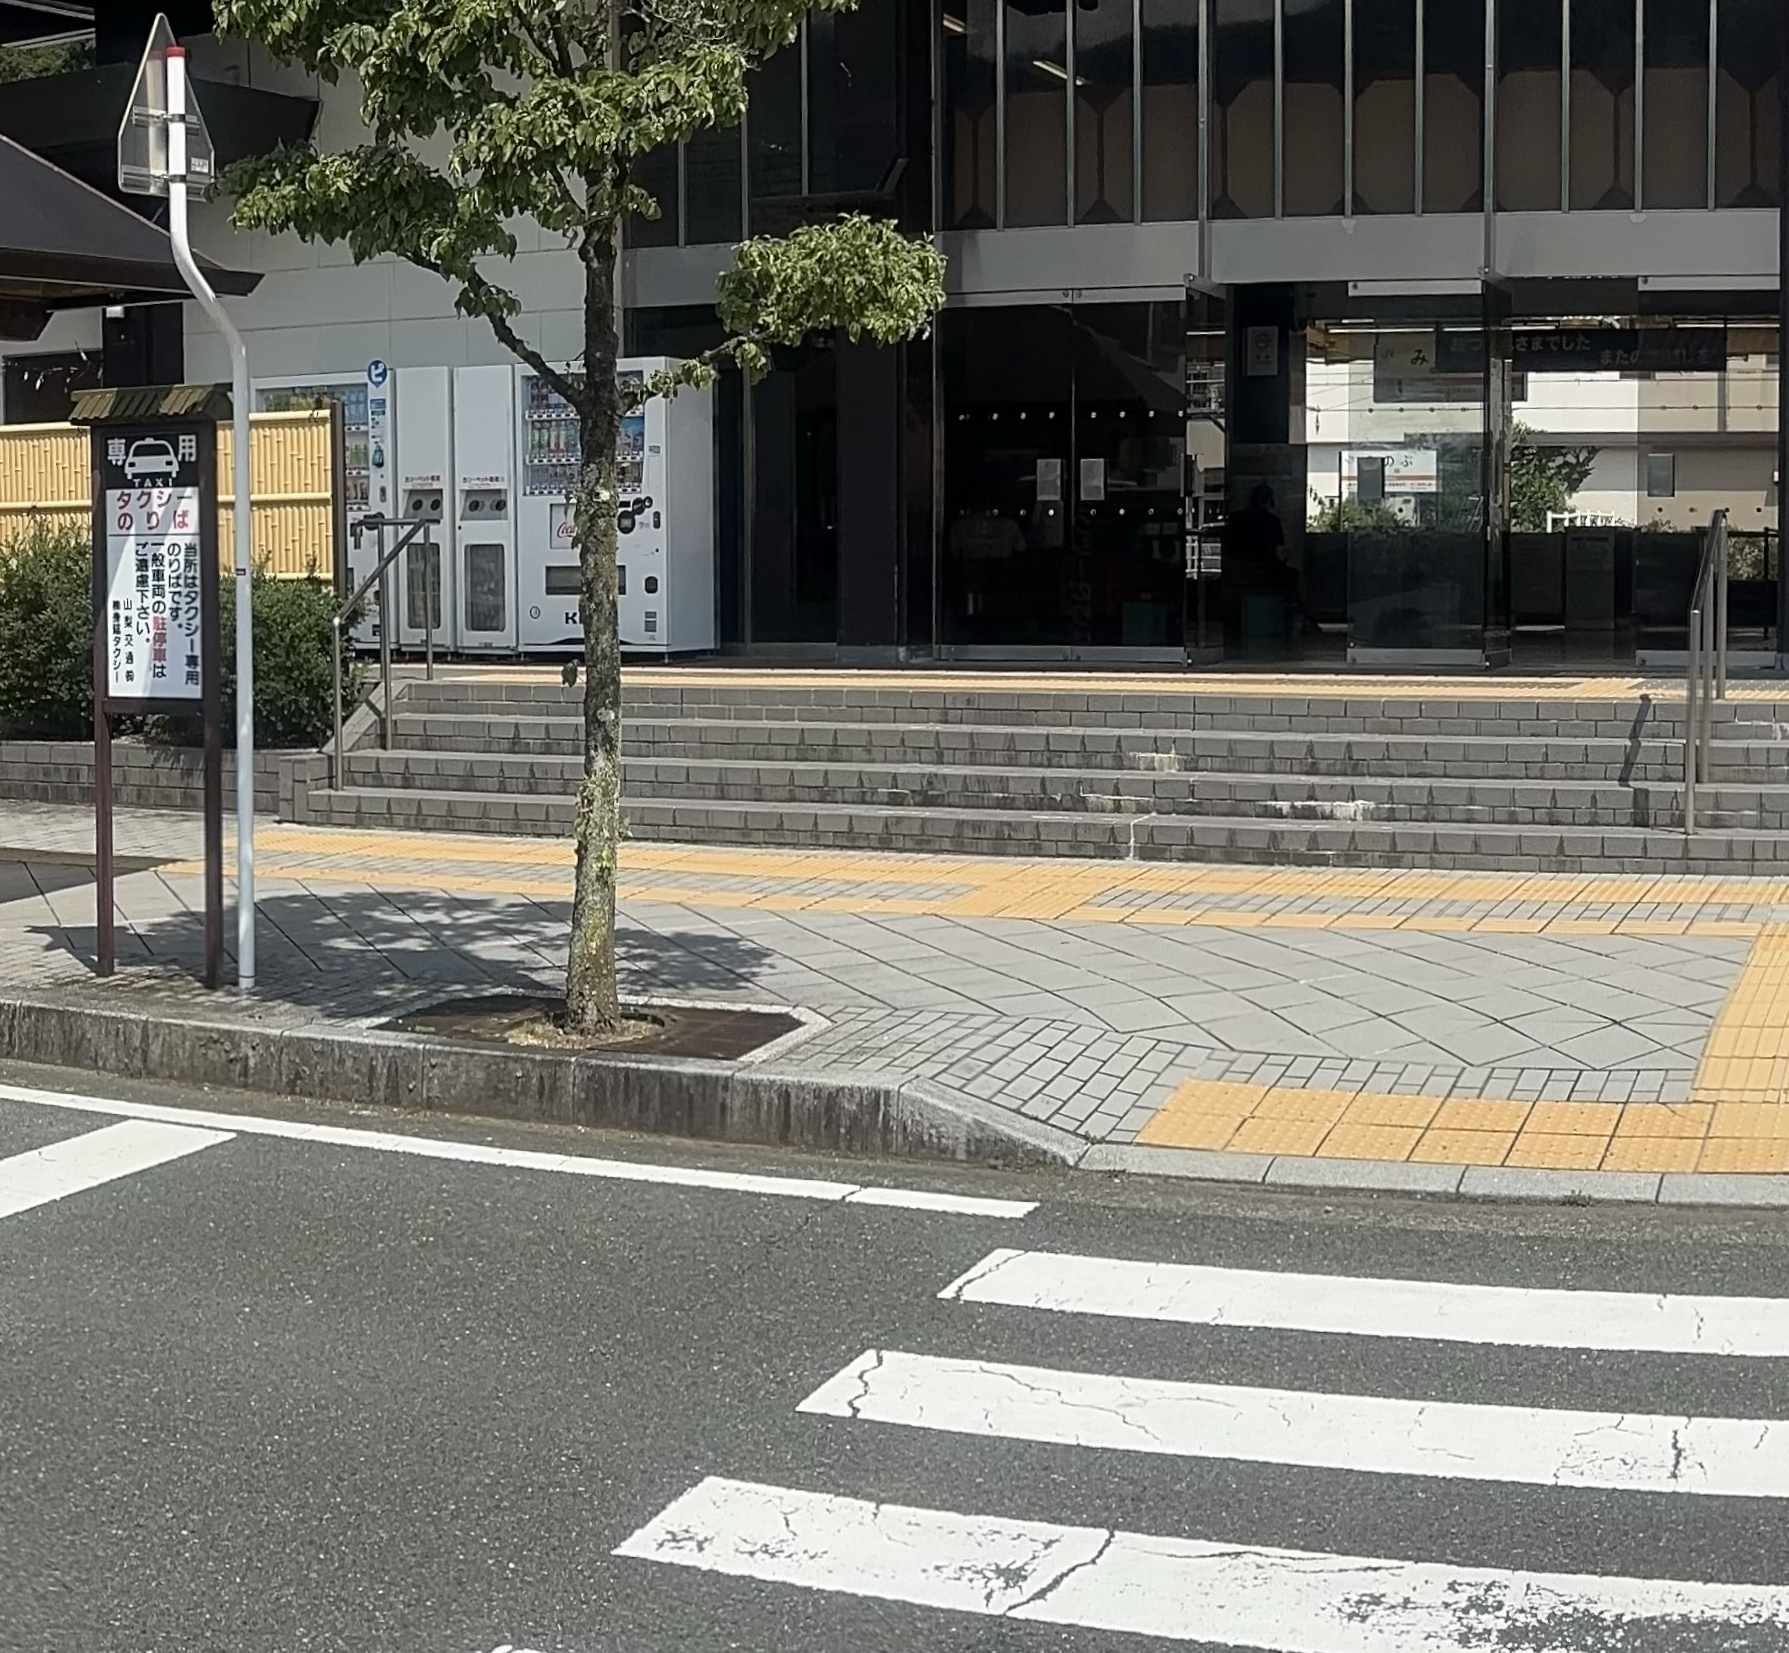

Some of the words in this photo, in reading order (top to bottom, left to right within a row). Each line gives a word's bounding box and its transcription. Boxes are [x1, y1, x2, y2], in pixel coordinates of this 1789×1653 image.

[107, 438, 126, 466] 専
[178, 435, 196, 462] 用
[117, 490, 192, 510] タクシー
[133, 478, 172, 488] TAXI
[117, 510, 189, 530] のりば
[135, 541, 150, 643] ご遠慮下さい。
[150, 542, 167, 679] 一般車両の駐停車は
[167, 543, 184, 629] のりばです。
[184, 542, 200, 686] 当所はタクシー専用
